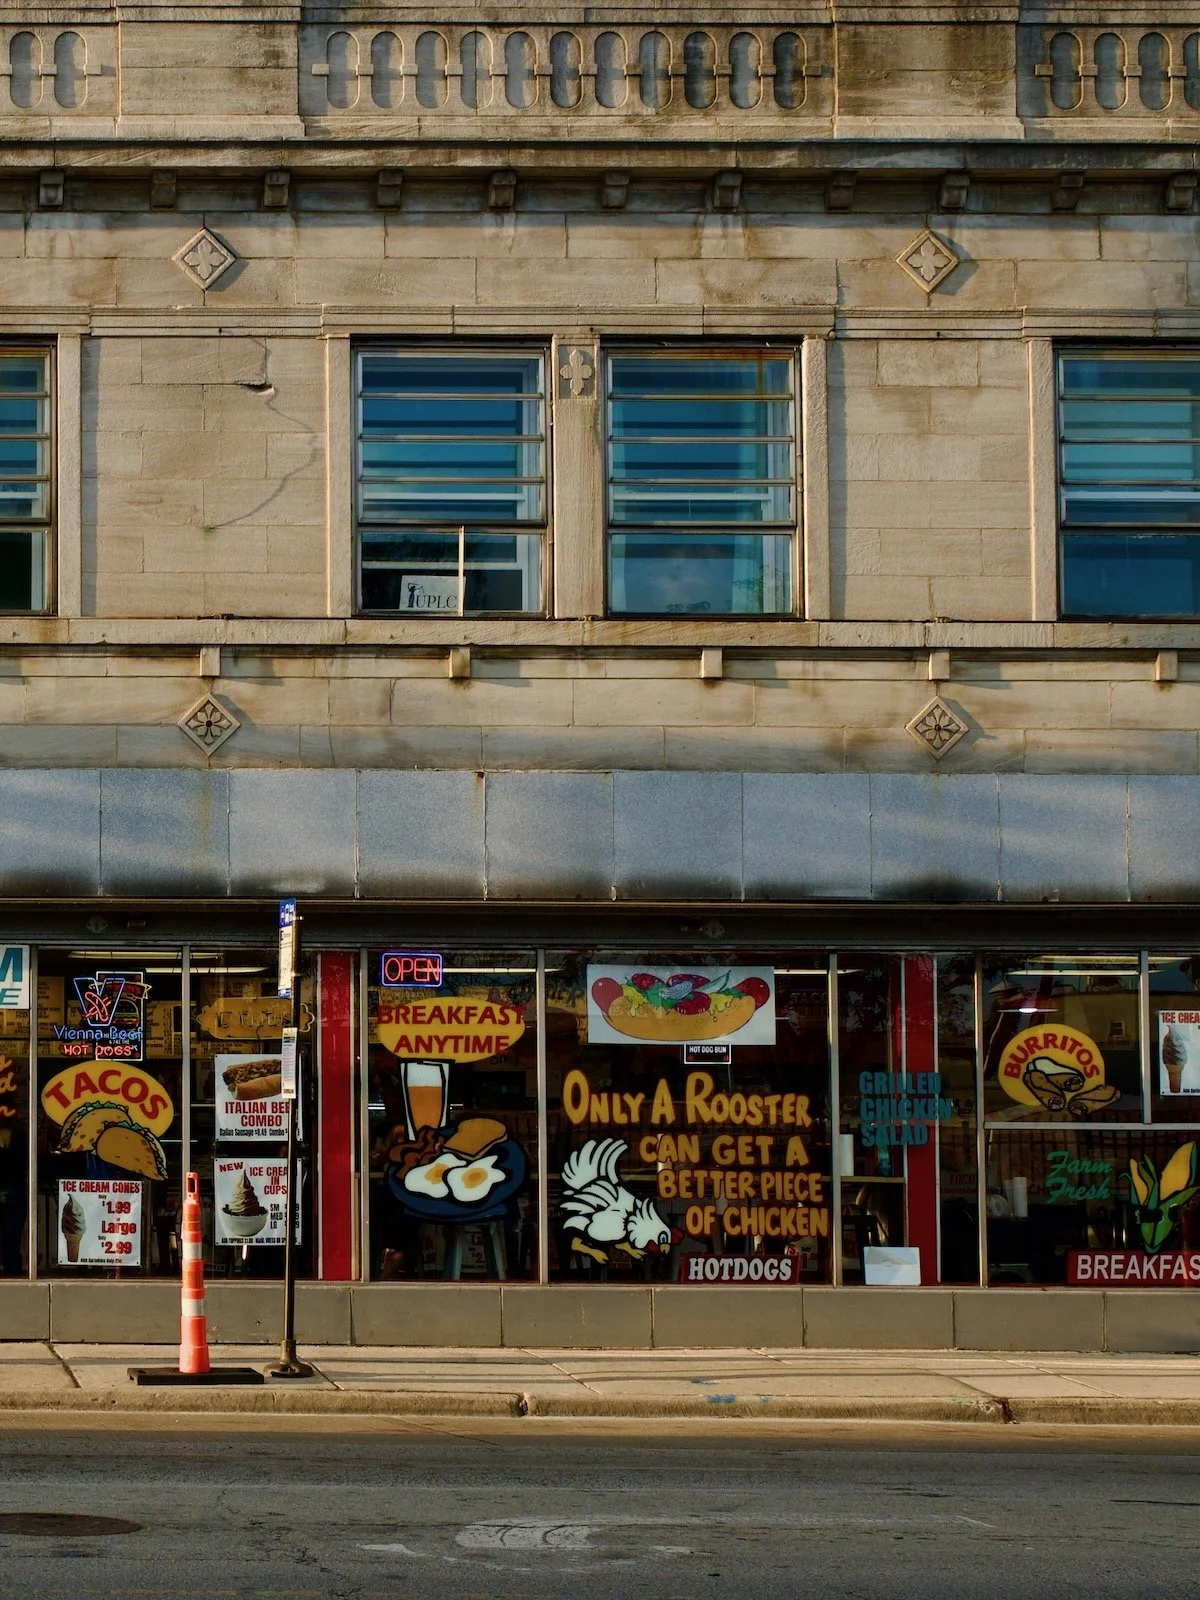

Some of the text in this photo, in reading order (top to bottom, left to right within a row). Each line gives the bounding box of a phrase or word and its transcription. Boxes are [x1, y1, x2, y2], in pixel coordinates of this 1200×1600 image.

[416, 595, 457, 608] UPLC
[384, 957, 440, 982] OPEN
[377, 1005, 527, 1025] BREAKFAST
[1162, 1012, 1176, 1024] ICE
[53, 1024, 104, 1040] Vienna
[63, 1044, 131, 1056] HOT DOGS
[394, 1035, 511, 1054] ANYTIME
[689, 1046, 701, 1054] HOT
[701, 1046, 714, 1054] DOG
[1003, 1032, 1100, 1080] BURRITOS
[858, 1071, 942, 1095] GRILLED
[45, 1069, 168, 1120] TACOS
[650, 1078, 676, 1125] A
[685, 1071, 813, 1128] ROOSTER
[225, 1102, 267, 1114] ITALIAN
[859, 1098, 953, 1120] CHICKEN
[241, 1115, 282, 1127] COMBO
[860, 1124, 929, 1148] SALAD
[639, 1134, 810, 1167] CAN GET A
[219, 1161, 244, 1173] NEW
[1045, 1150, 1113, 1176] Farm
[249, 1167, 264, 1177] ICE
[62, 1181, 140, 1193] ICE CREAM CONES
[270, 1176, 280, 1185] IN
[657, 1169, 824, 1202] BETTER PIECE
[264, 1185, 288, 1195] CUPS
[1044, 1176, 1111, 1204] Fresh
[102, 1200, 131, 1214] $1.99
[270, 1203, 280, 1212] SM
[270, 1212, 283, 1220] MED
[685, 1205, 829, 1237] OF CHICKEN
[101, 1220, 137, 1236] Large
[101, 1241, 133, 1254] $2.99
[688, 1257, 792, 1281] HOTDOGS
[1076, 1254, 1200, 1280] BREAKFAS
